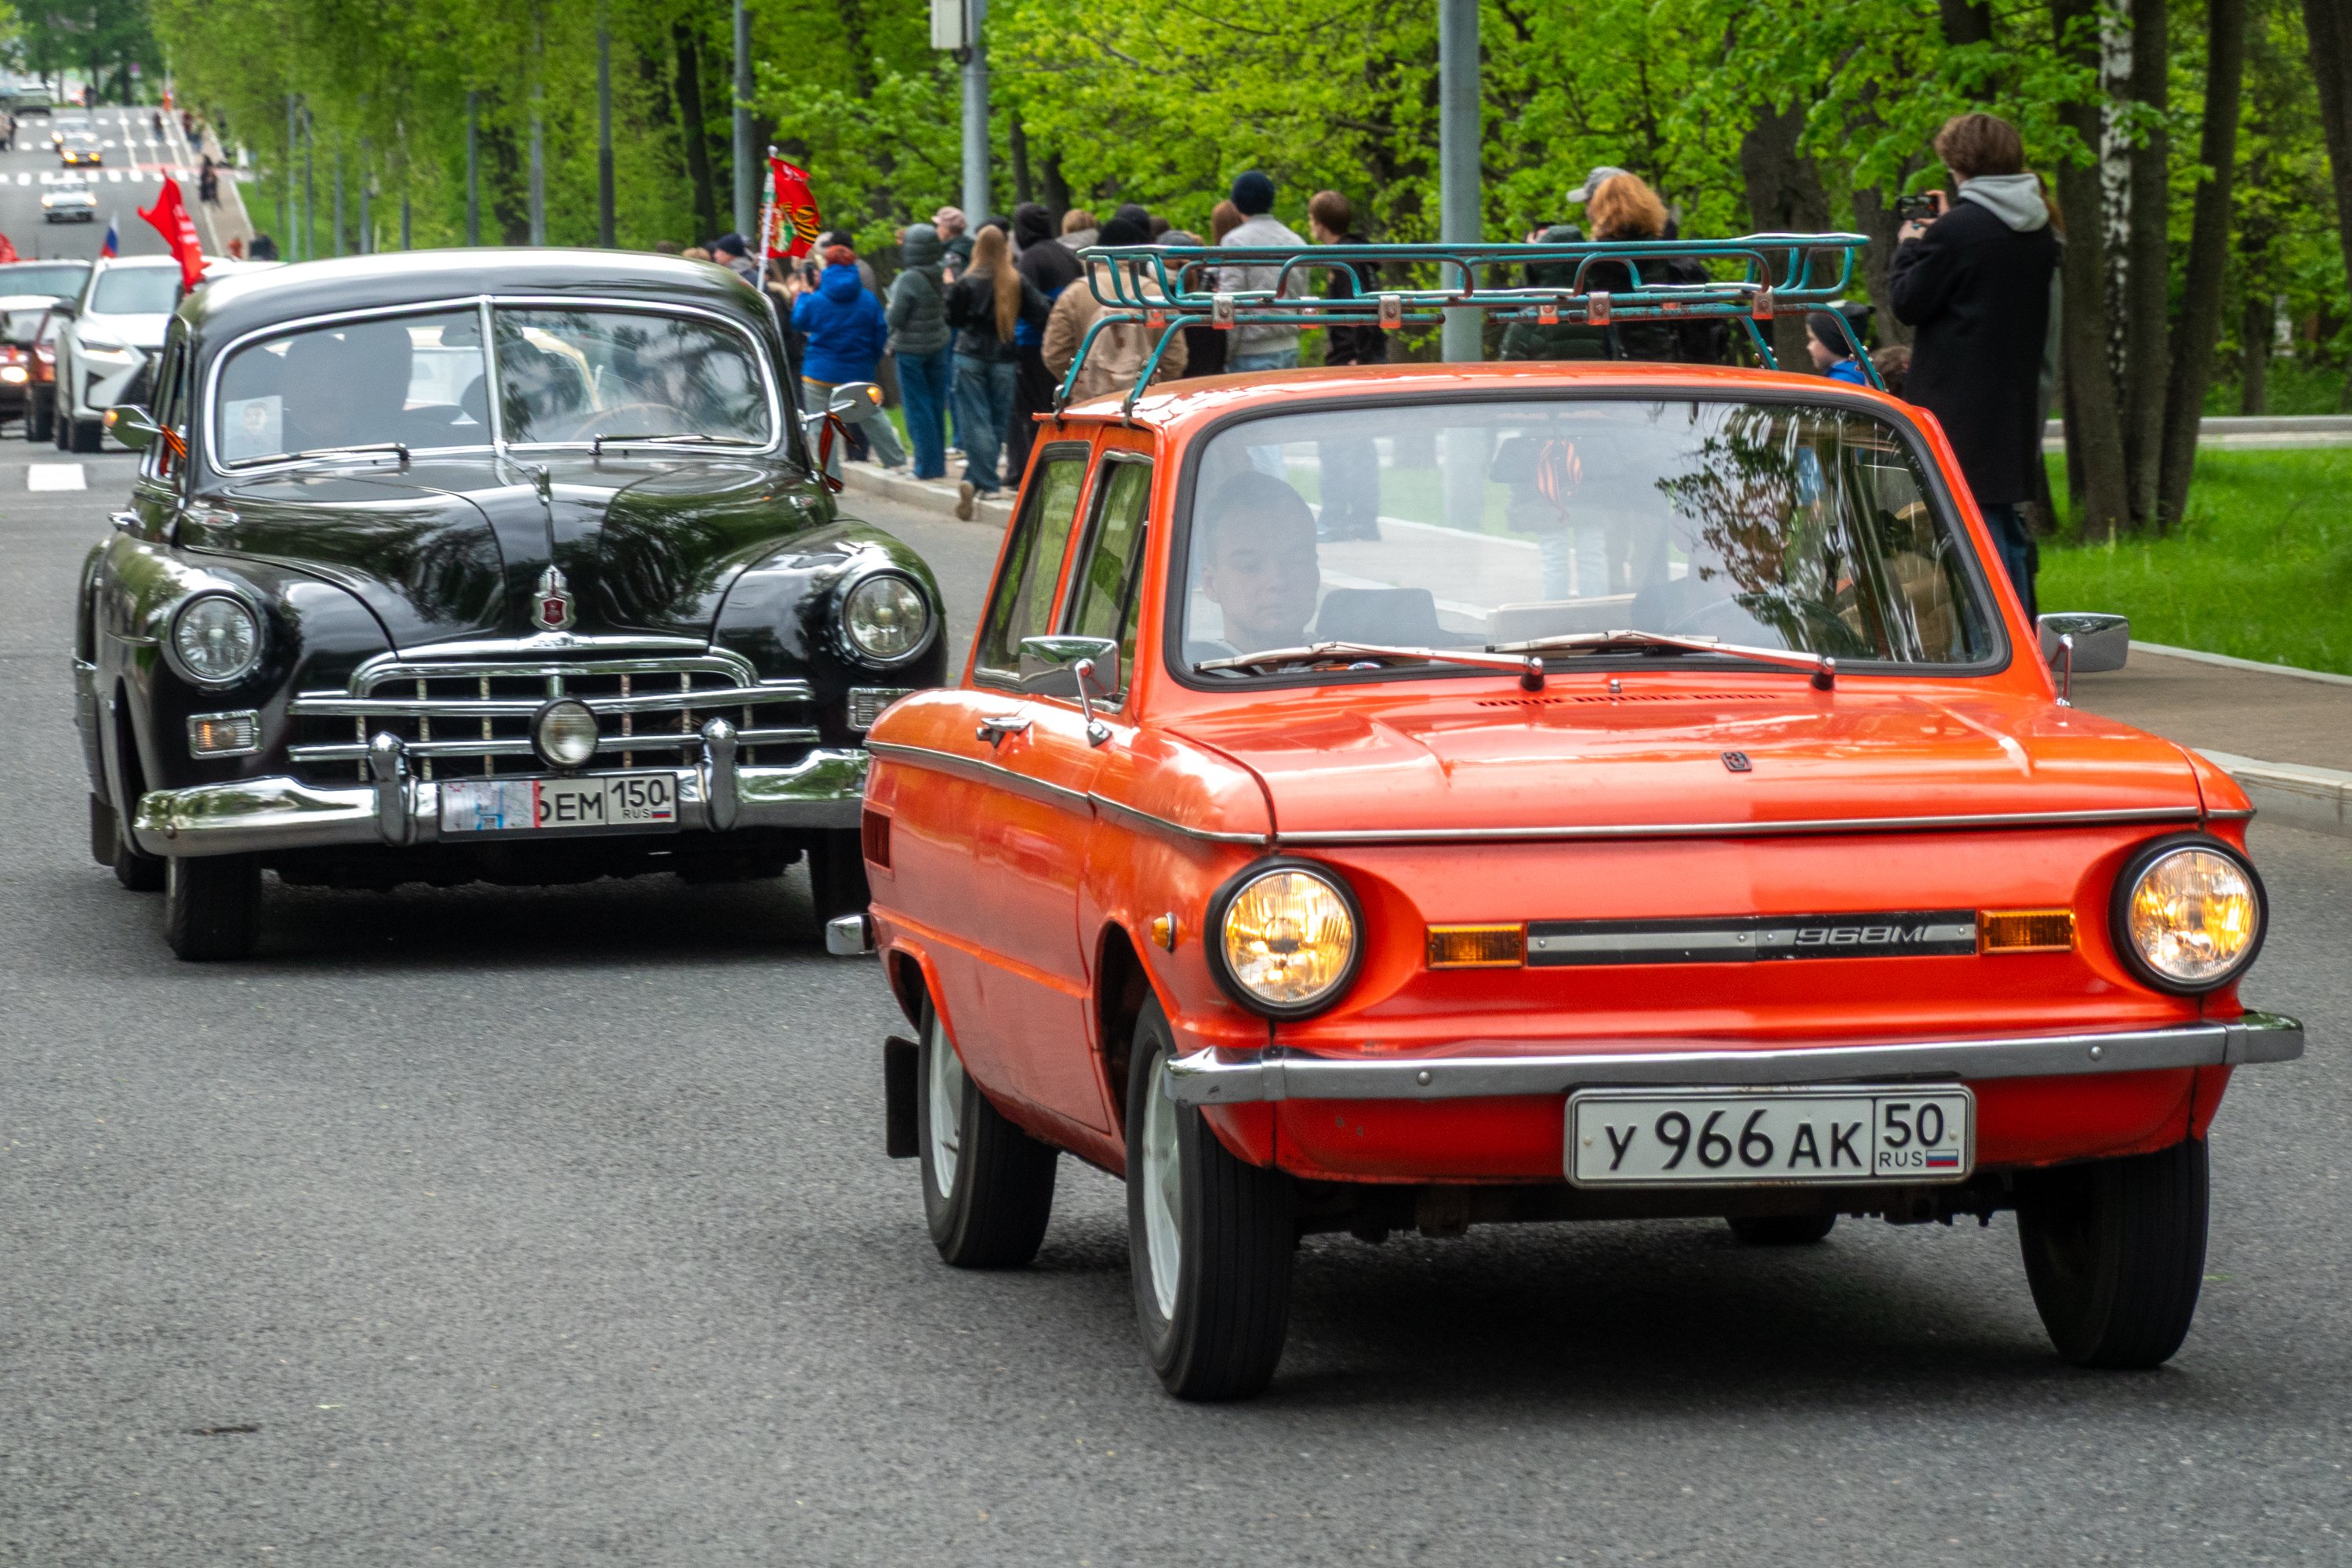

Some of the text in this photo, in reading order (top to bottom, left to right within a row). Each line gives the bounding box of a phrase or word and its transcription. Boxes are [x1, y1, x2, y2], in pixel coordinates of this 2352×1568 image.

[611, 779, 665, 808] 150
[623, 808, 650, 818] RUS
[1883, 1102, 1944, 1147] 50
[1879, 1151, 1923, 1167] RUS
